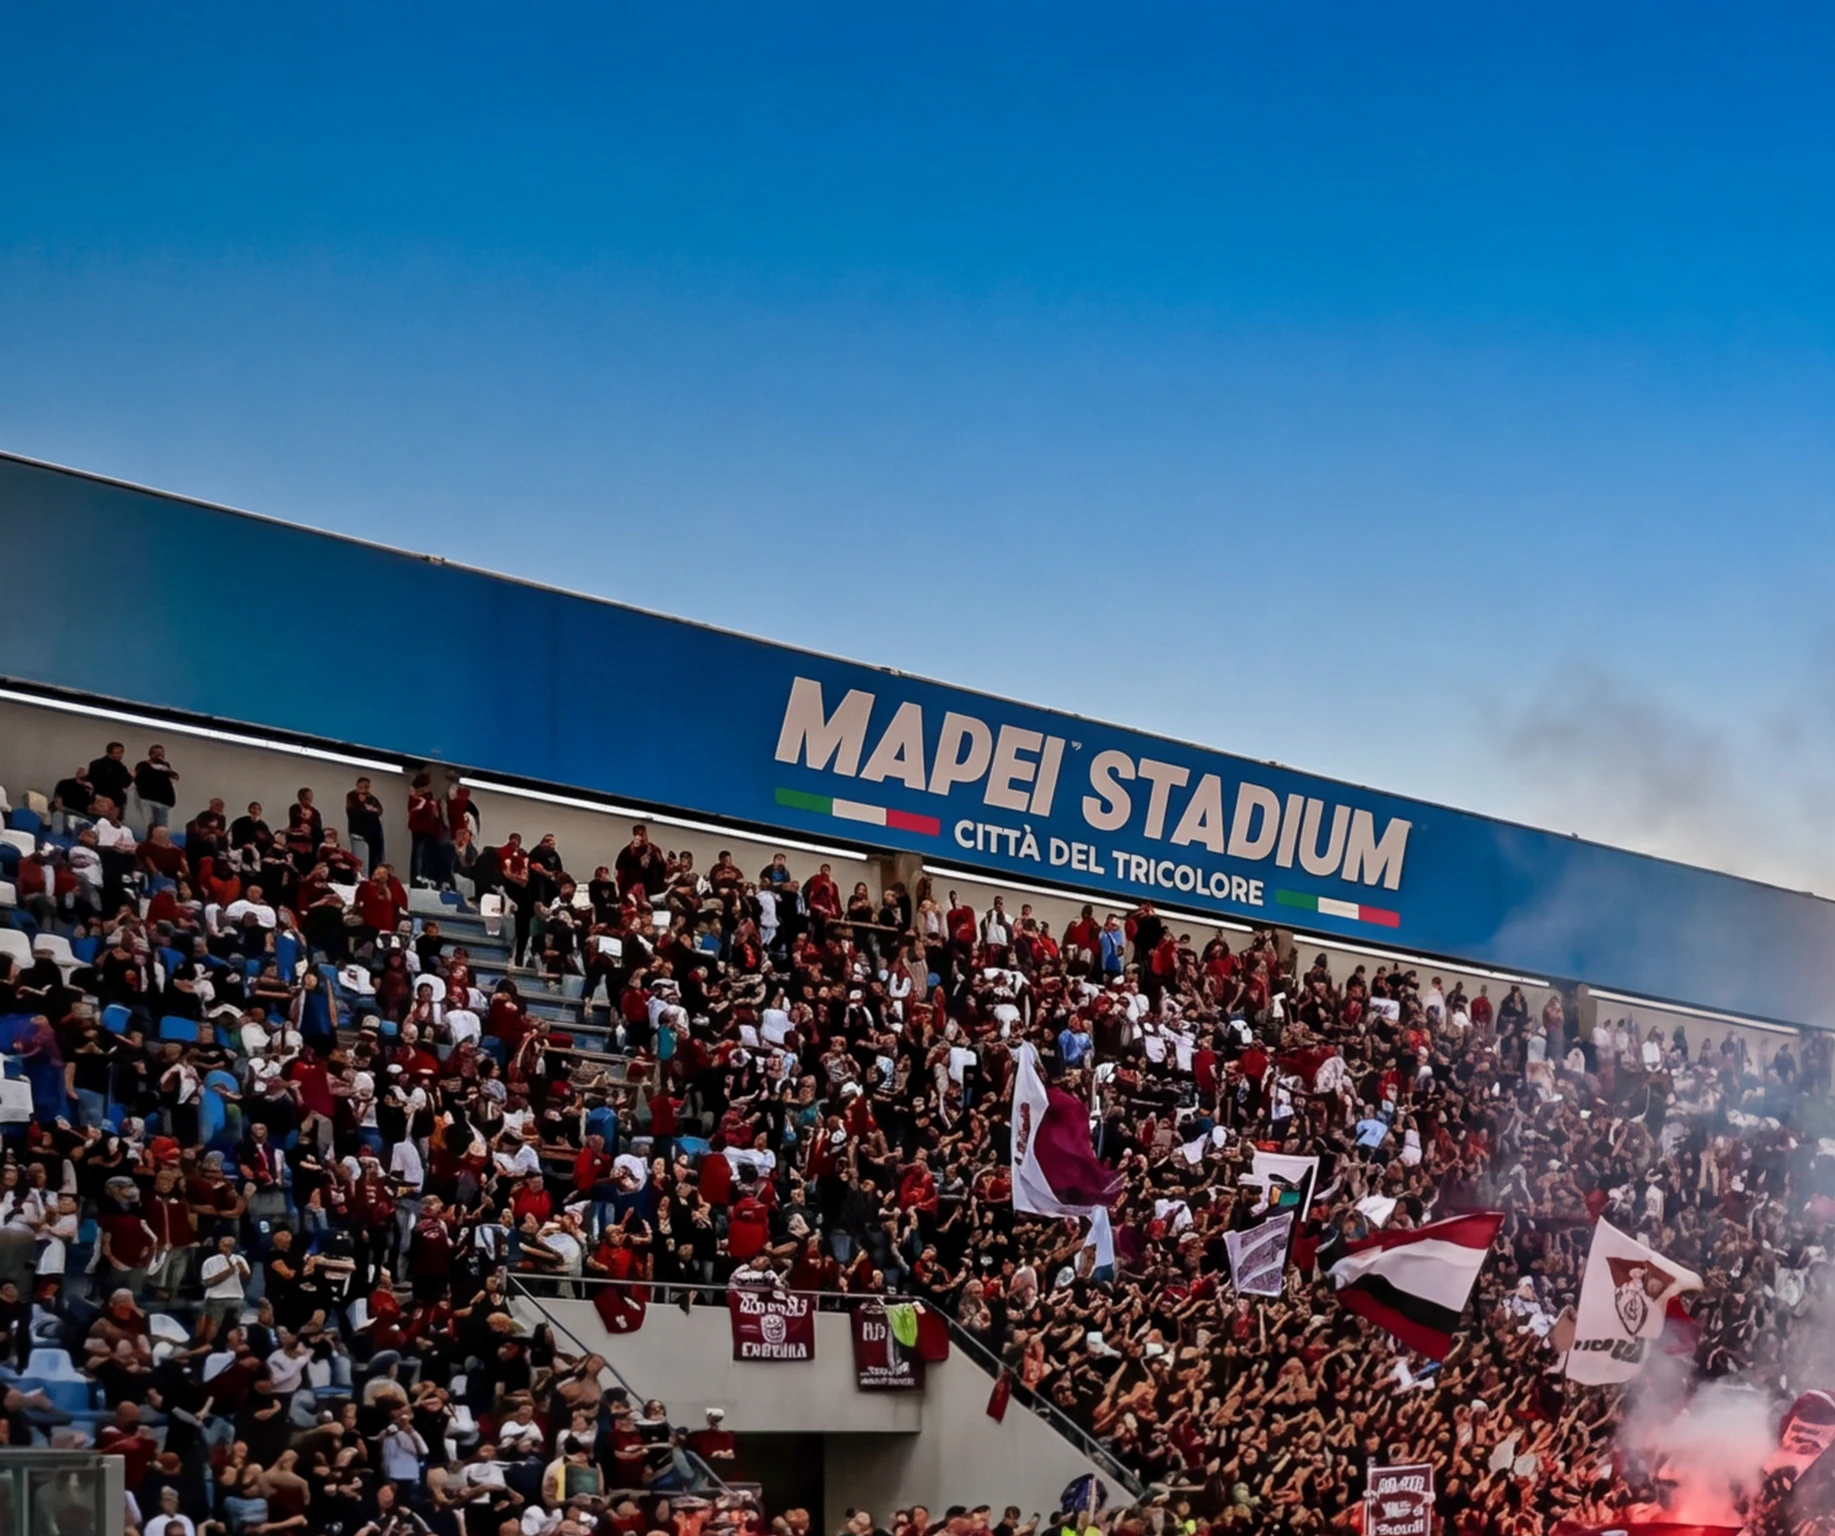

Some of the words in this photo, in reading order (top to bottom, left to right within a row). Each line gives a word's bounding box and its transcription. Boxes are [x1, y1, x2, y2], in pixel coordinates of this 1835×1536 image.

[775, 676, 1066, 817] MAPEI
[1082, 749, 1412, 891] STADIUM
[954, 819, 1041, 863] CITTÀ
[1049, 838, 1106, 876] DEL
[1112, 850, 1264, 907] TRICOLORE
